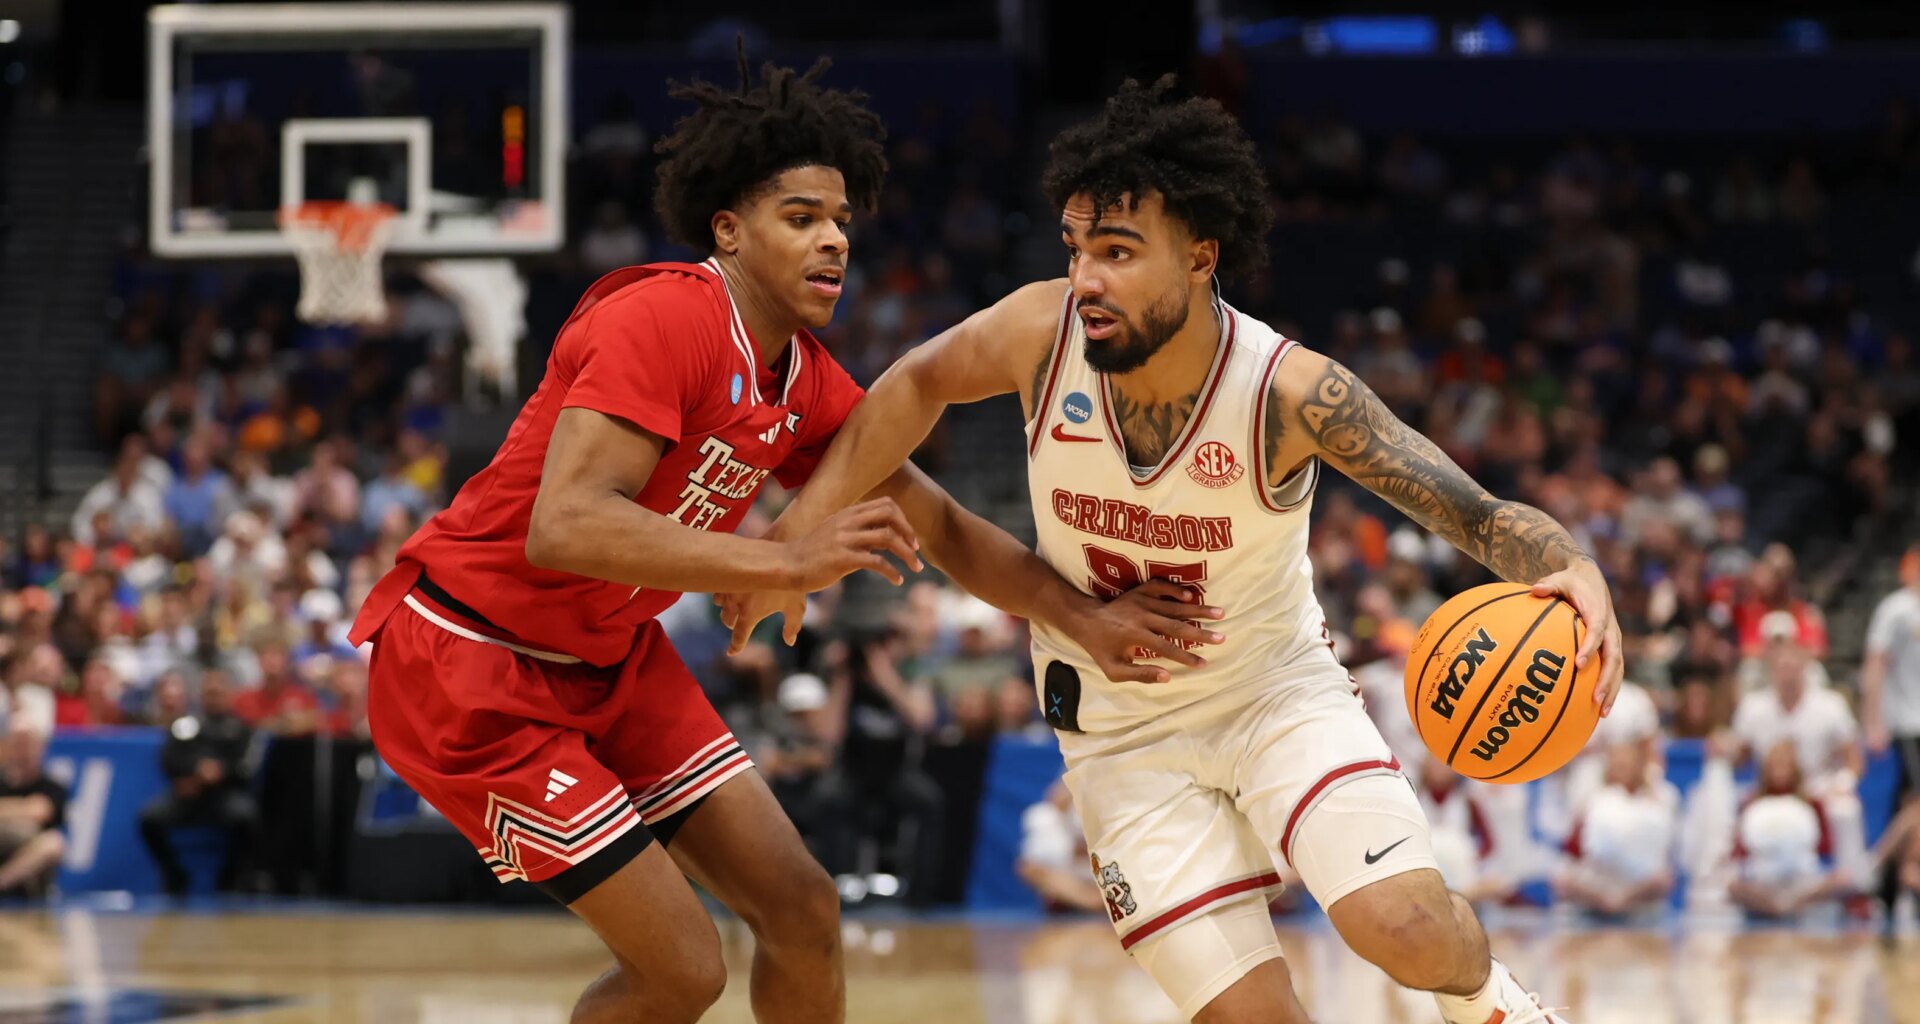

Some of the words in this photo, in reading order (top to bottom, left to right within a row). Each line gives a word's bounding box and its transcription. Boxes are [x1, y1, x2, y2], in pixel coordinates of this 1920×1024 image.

[1065, 403, 1089, 420] NCAA
[687, 435, 770, 499] TEXAS
[1193, 472, 1238, 487] GRADUATE
[1197, 443, 1233, 476] SEC
[666, 481, 732, 532] TEC
[1052, 488, 1234, 552] CRIMSON
[1431, 627, 1498, 720] NCAA
[1500, 684, 1513, 702] EVO
[1469, 649, 1566, 761] Wilson
[1489, 703, 1502, 720] NXT
